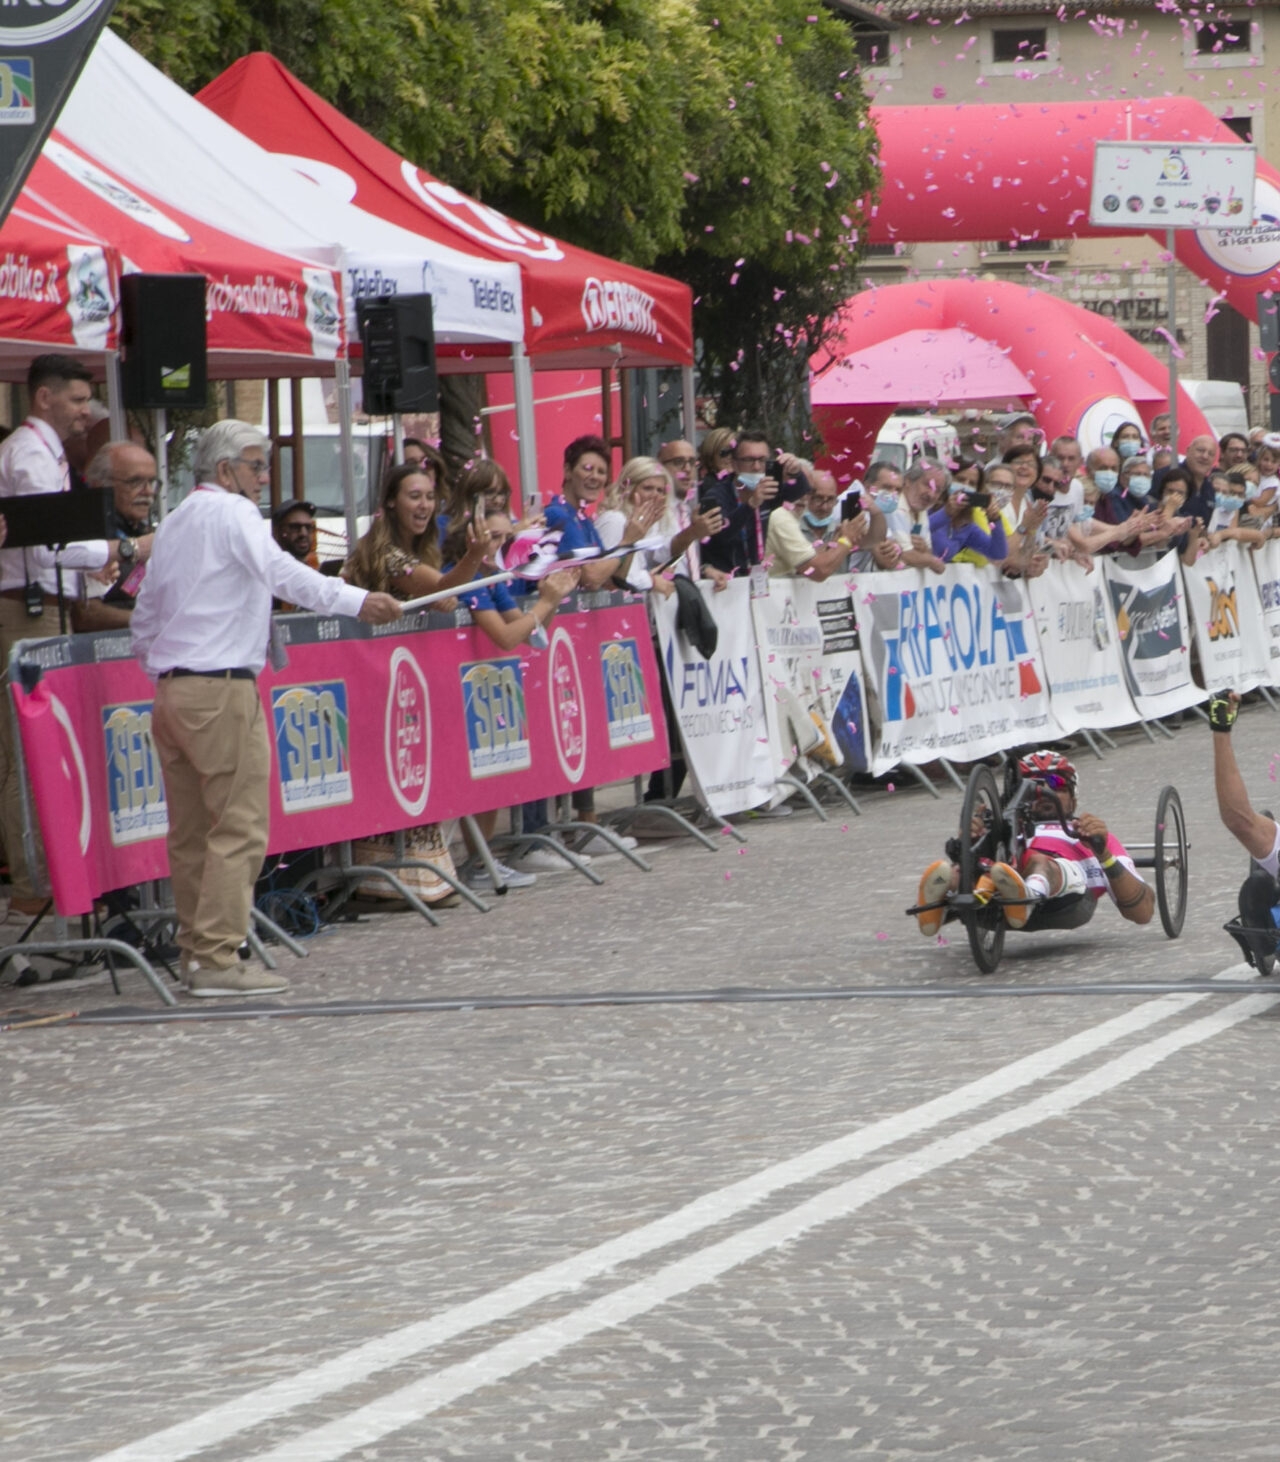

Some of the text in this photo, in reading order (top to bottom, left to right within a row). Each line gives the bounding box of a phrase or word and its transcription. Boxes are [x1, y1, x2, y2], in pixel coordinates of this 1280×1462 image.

[469, 277, 516, 315] Teleflex
[1083, 298, 1169, 320] HOTEL
[900, 583, 1015, 680] FRAGOLA
[472, 666, 520, 749] SEO
[607, 647, 642, 722] SEO
[112, 711, 161, 812] SEO
[285, 691, 340, 781] SEO
[397, 747, 425, 789] Bike
